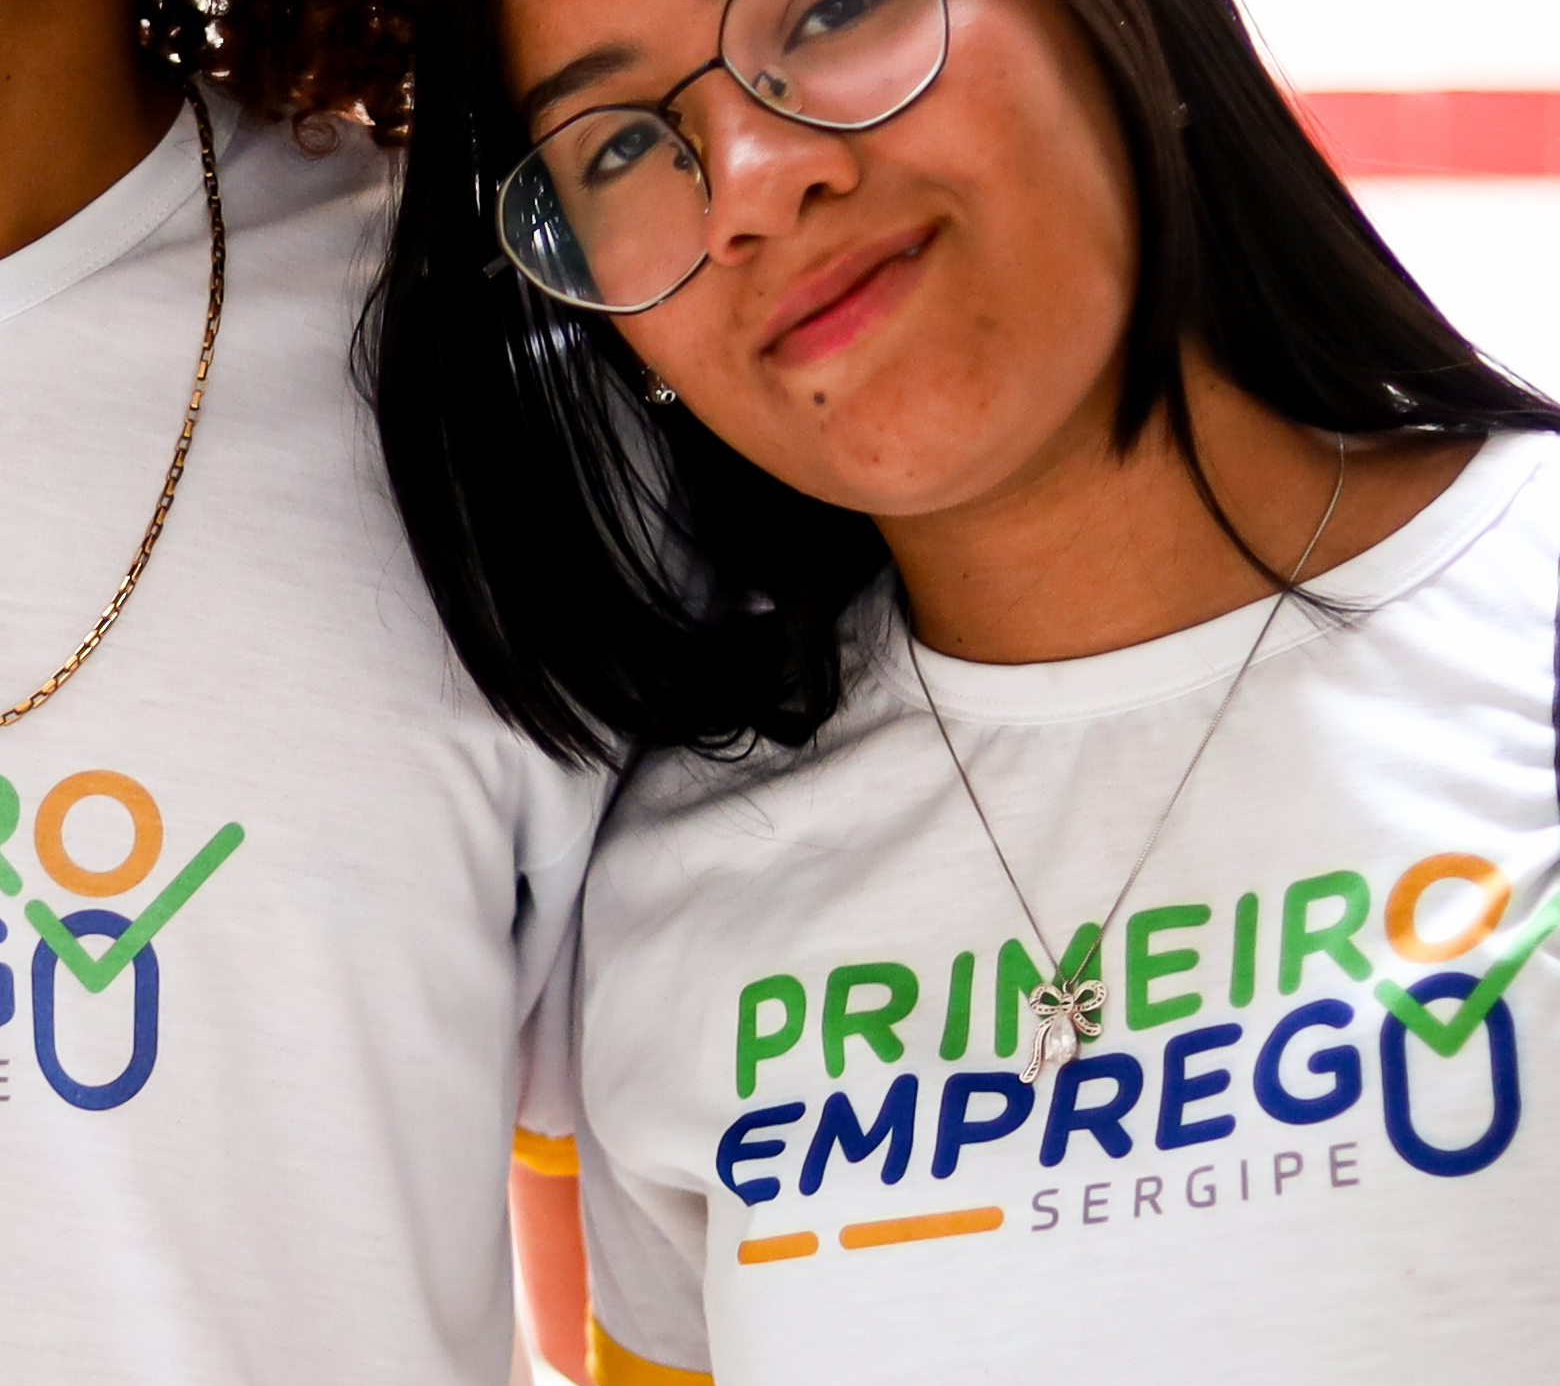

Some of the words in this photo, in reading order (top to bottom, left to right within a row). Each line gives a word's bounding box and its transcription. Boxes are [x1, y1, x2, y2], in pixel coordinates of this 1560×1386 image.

[716, 972, 1521, 1206] EMPREGO
[737, 852, 1512, 1098] PRIMEIRO
[1030, 1141, 1361, 1232] SERGIPE
